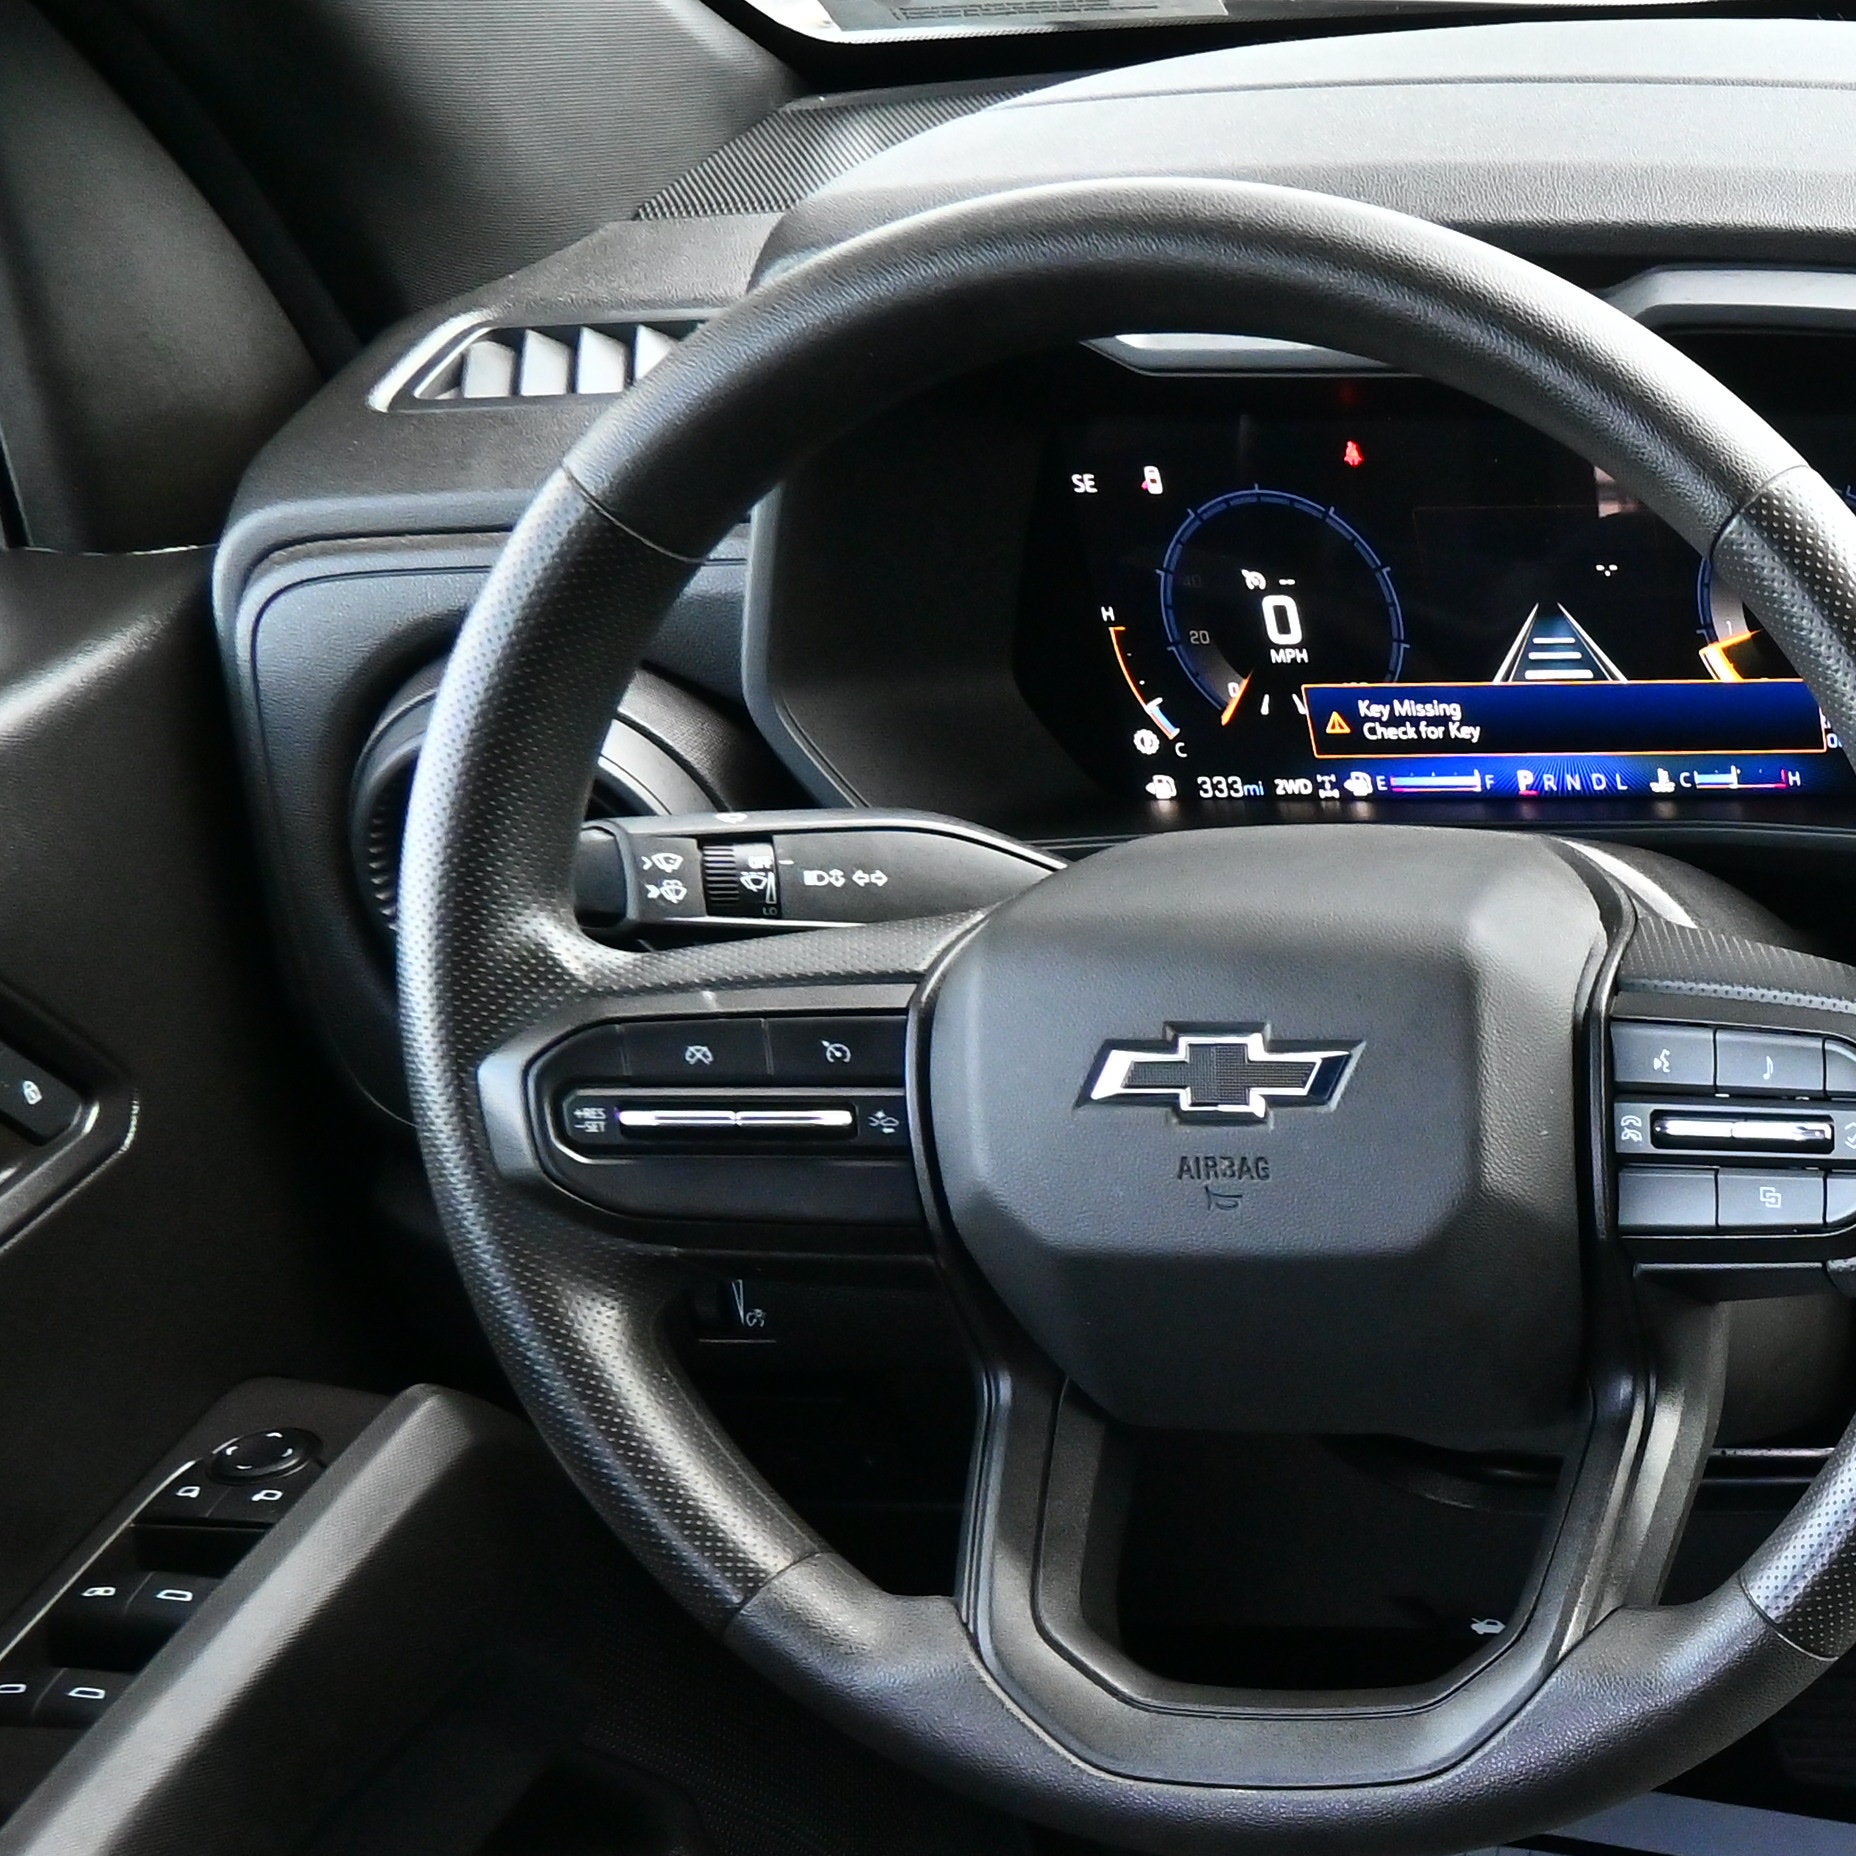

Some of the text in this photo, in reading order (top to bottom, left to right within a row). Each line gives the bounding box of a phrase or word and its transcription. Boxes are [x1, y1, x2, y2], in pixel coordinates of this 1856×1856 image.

[1071, 473, 1098, 494] SE
[1261, 594, 1302, 645] 0
[1189, 630, 1210, 645] 20
[1269, 648, 1309, 664] MPH
[1357, 699, 1462, 721] Key Missing
[1362, 721, 1481, 743] Check for Key
[1273, 778, 1313, 796] 2WD
[1516, 769, 1628, 792] P R N D L
[1176, 1156, 1271, 1181] AIRBAG
